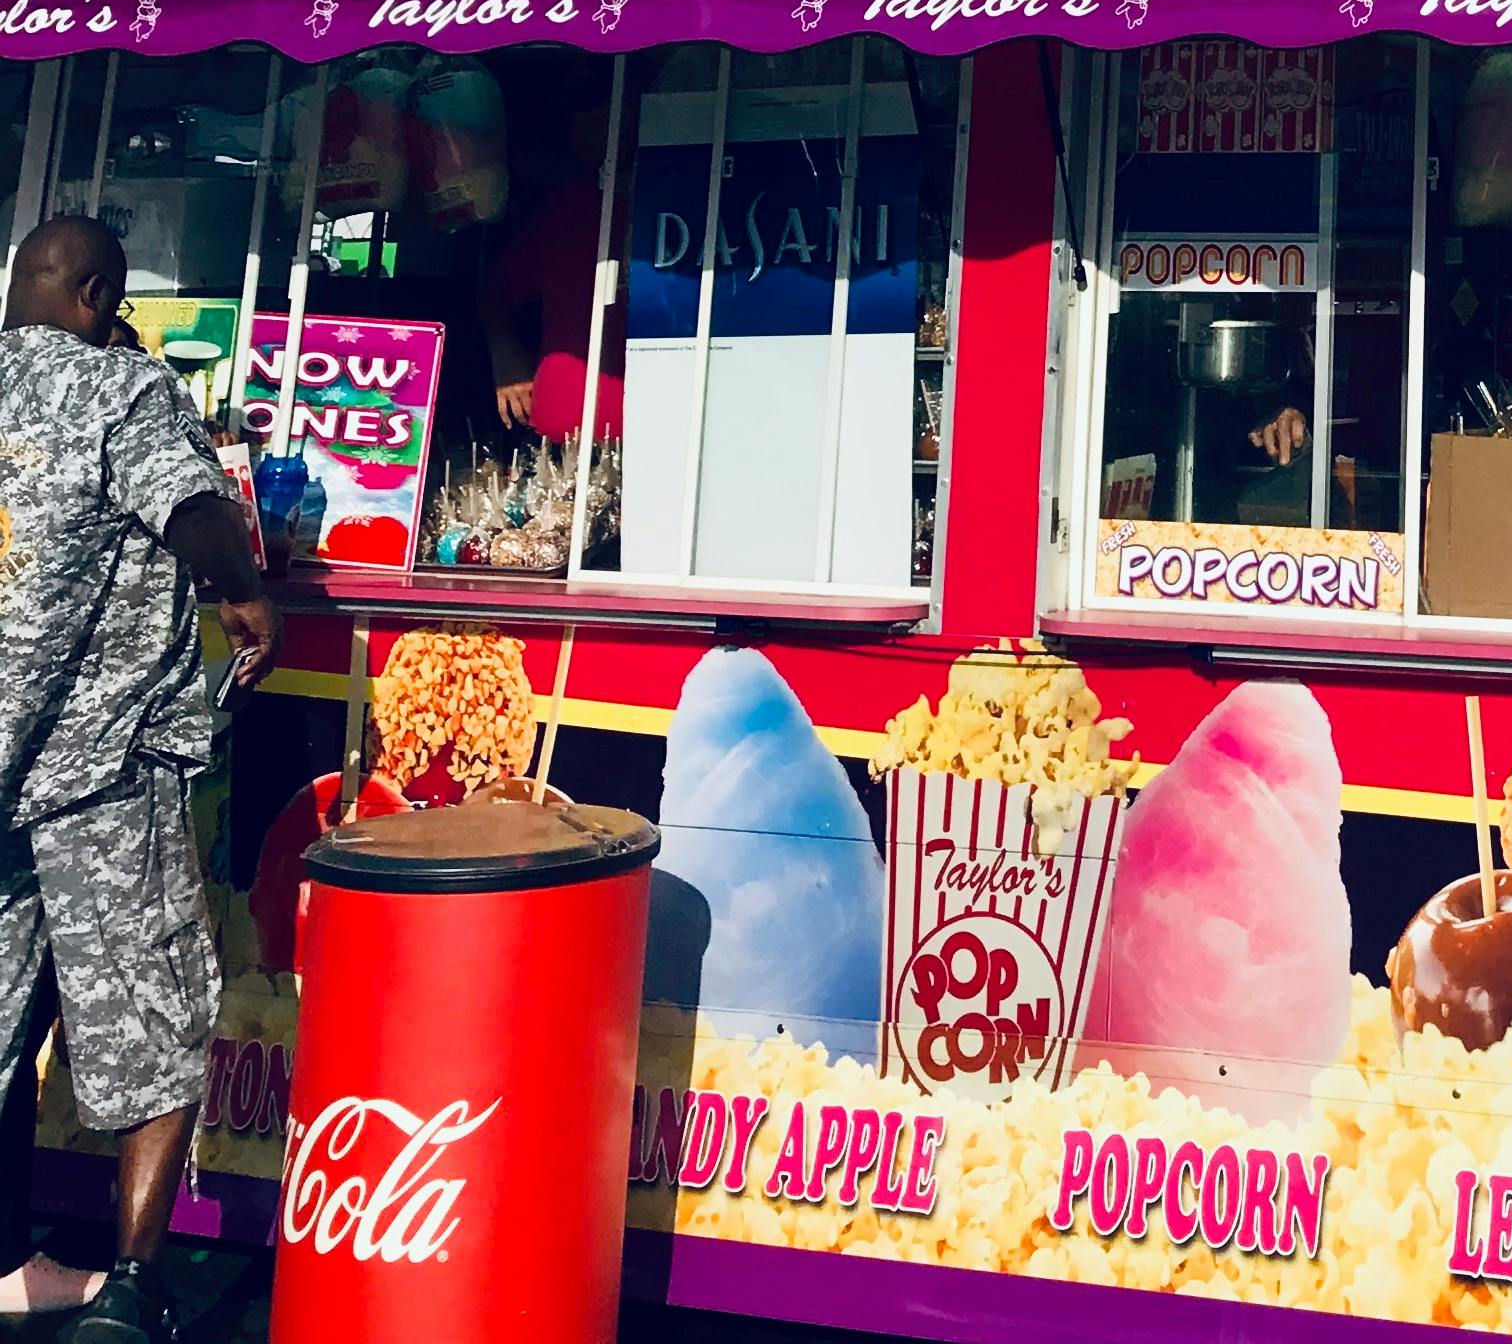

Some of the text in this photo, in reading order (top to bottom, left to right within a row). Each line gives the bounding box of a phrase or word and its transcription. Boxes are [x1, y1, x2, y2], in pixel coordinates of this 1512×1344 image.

[246, 348, 409, 388] NOW
[240, 402, 410, 444] ONES
[1101, 521, 1136, 555] FRESH
[1368, 532, 1400, 576] FRESH
[1118, 543, 1380, 609] POPCORN
[924, 837, 1066, 906] Taylor's
[909, 931, 1020, 1024] POP
[917, 997, 1050, 1084] CORN
[628, 1083, 946, 1215] NDY APPLE
[1051, 1127, 1330, 1260] POPCORN
